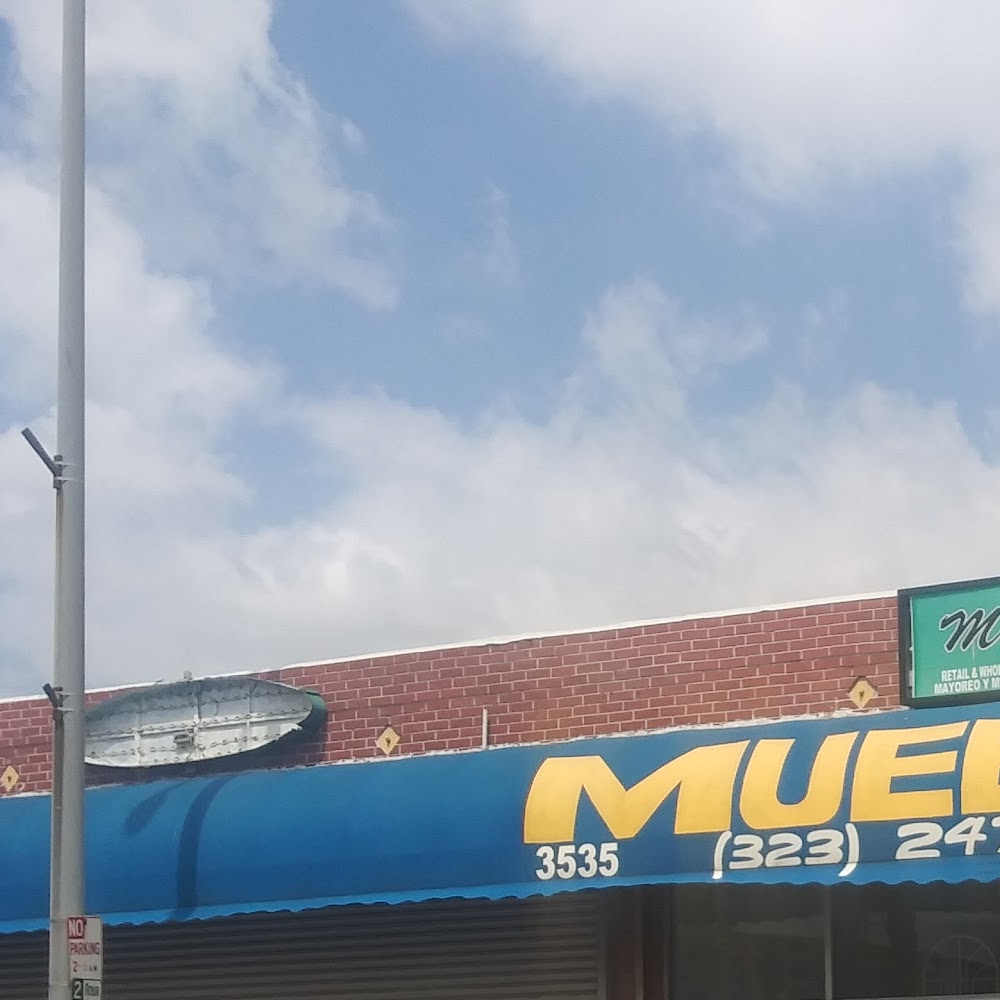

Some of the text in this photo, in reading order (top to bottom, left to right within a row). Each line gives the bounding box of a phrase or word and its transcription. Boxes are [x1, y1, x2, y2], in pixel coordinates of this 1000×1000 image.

[941, 668, 970, 682] RETAIL
[971, 667, 978, 678] &
[934, 680, 981, 694] MAYOREO
[982, 679, 990, 689] Y
[712, 824, 862, 880] (323)
[535, 843, 620, 880] 3535
[68, 919, 84, 937] NO
[70, 942, 100, 955] PARKING
